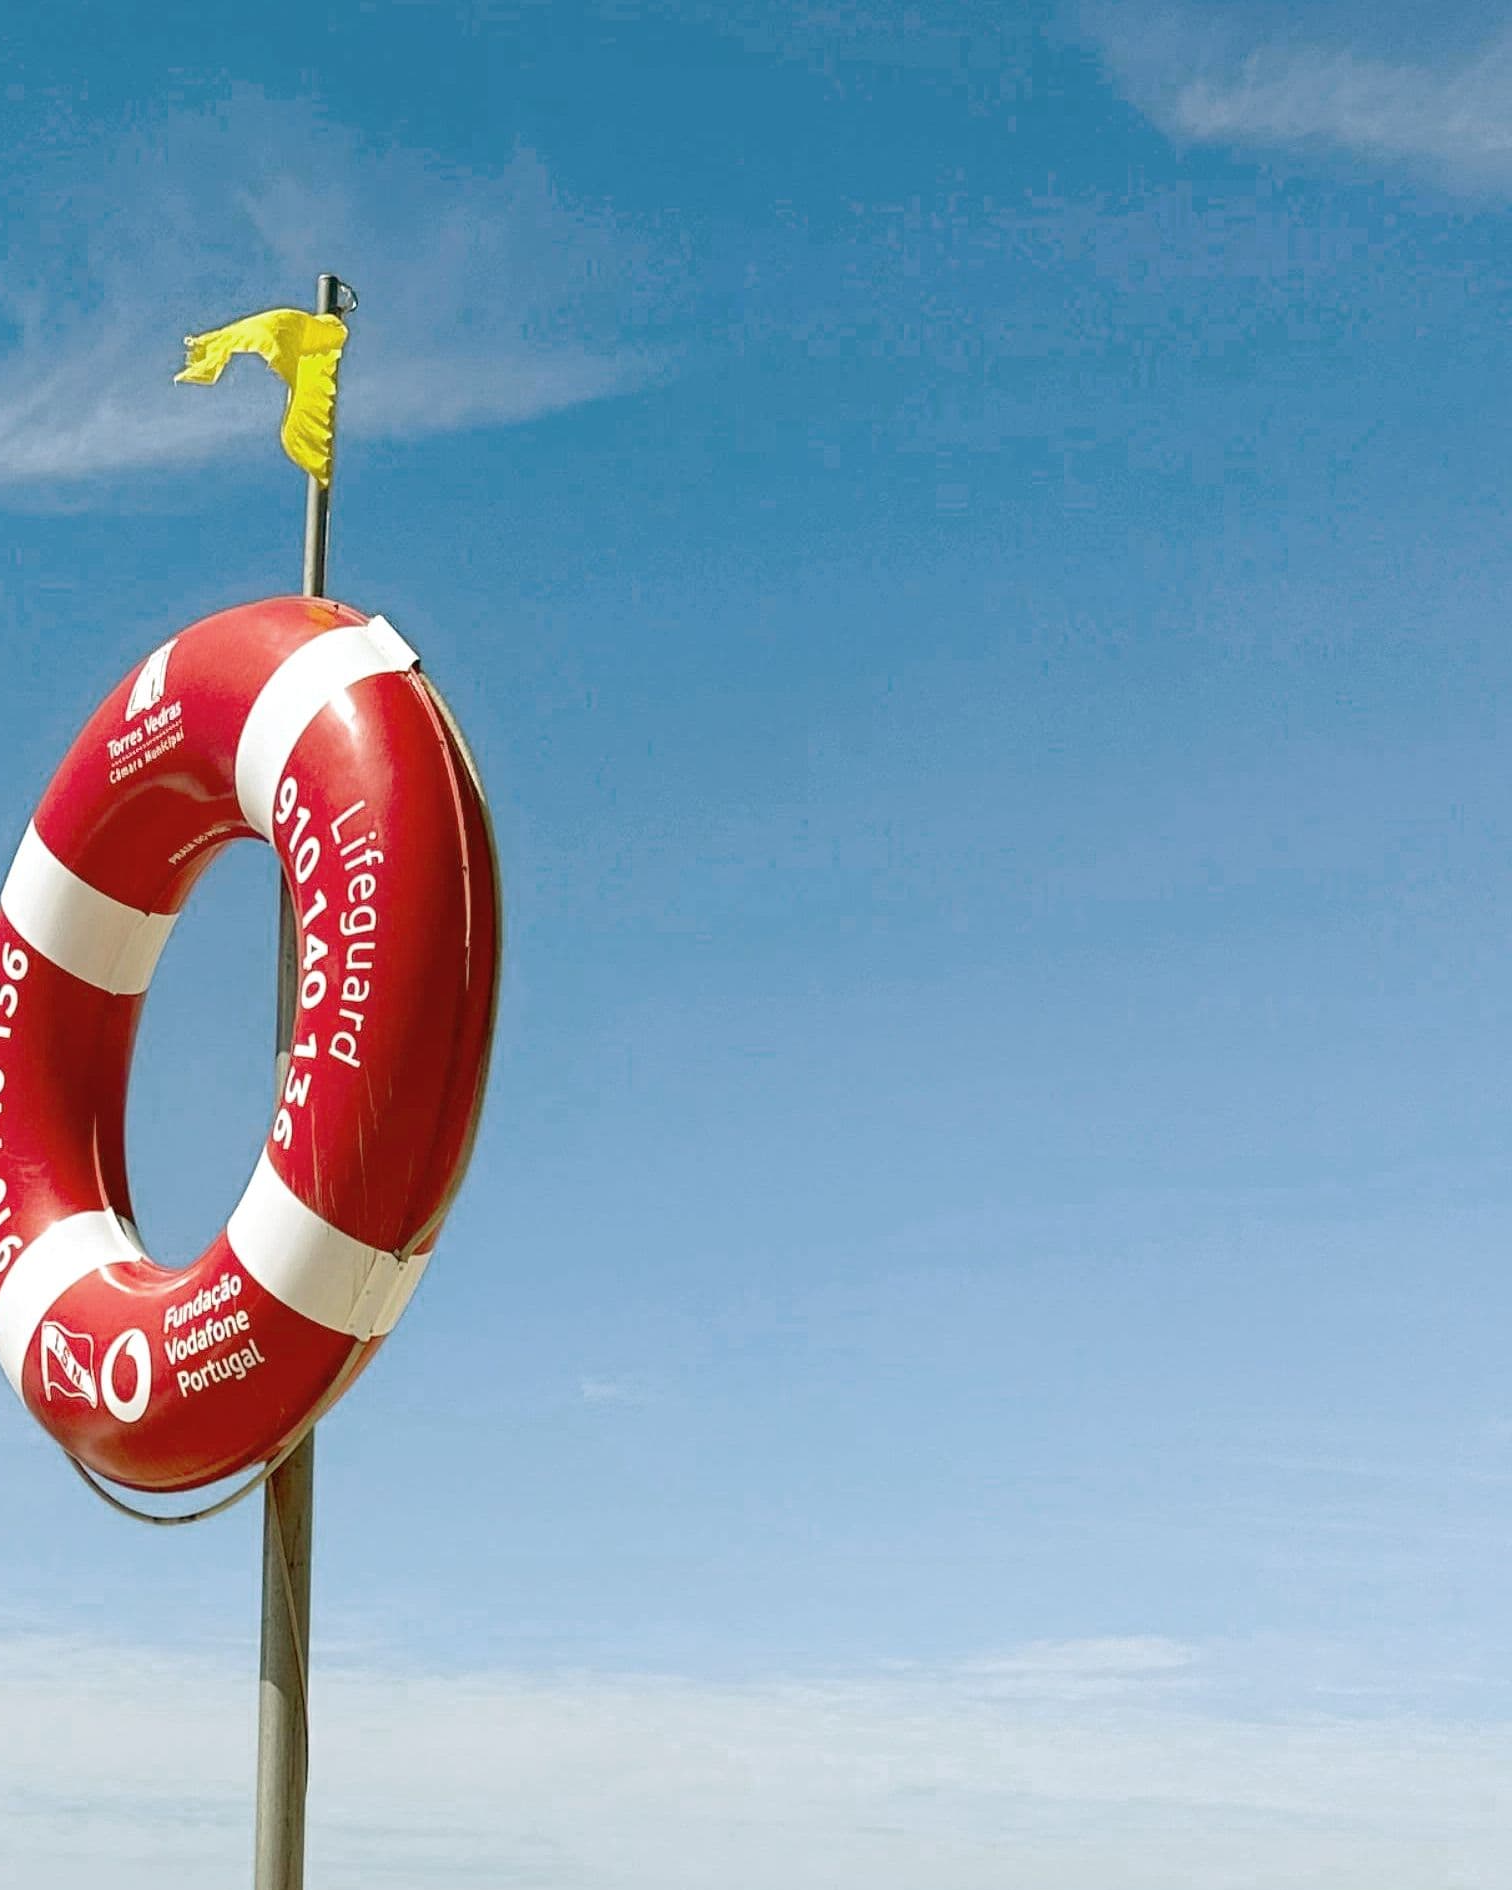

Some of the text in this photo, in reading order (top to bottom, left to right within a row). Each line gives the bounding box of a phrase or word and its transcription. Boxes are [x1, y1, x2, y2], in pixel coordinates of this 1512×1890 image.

[107, 701, 182, 759] Torres Vedras
[145, 725, 184, 763] Municipal
[273, 776, 329, 1150] 910 140 136
[328, 800, 384, 1068] Lifeguard
[163, 1273, 242, 1334] Fundação
[164, 1310, 250, 1366] Vodafone
[177, 1338, 266, 1398] Portugal
